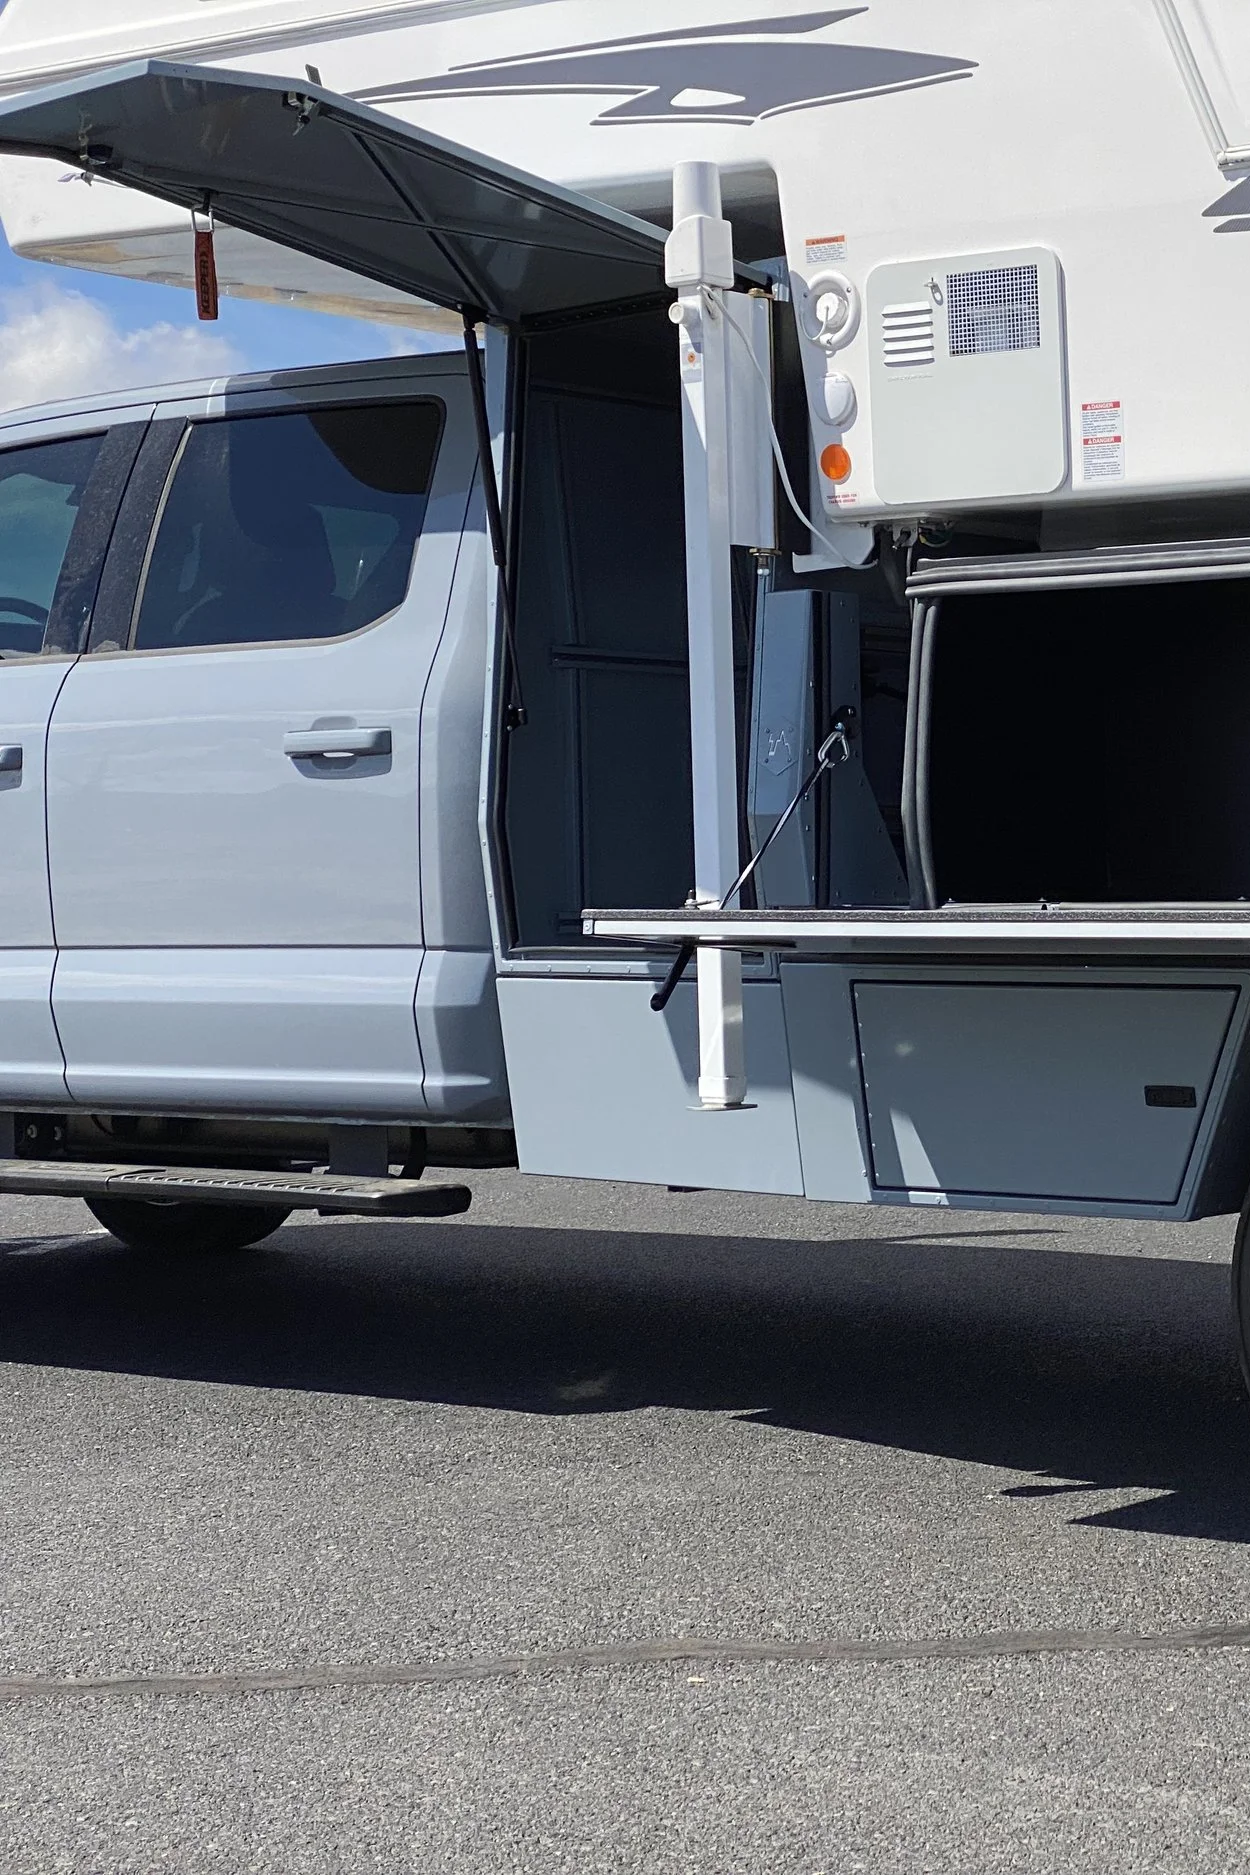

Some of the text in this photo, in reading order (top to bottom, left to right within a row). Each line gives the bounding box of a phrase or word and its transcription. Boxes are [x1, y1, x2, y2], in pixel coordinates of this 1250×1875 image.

[199, 259, 210, 314] KEEPER
[1091, 402, 1114, 410] DANGER
[1093, 437, 1115, 445] DANGER
